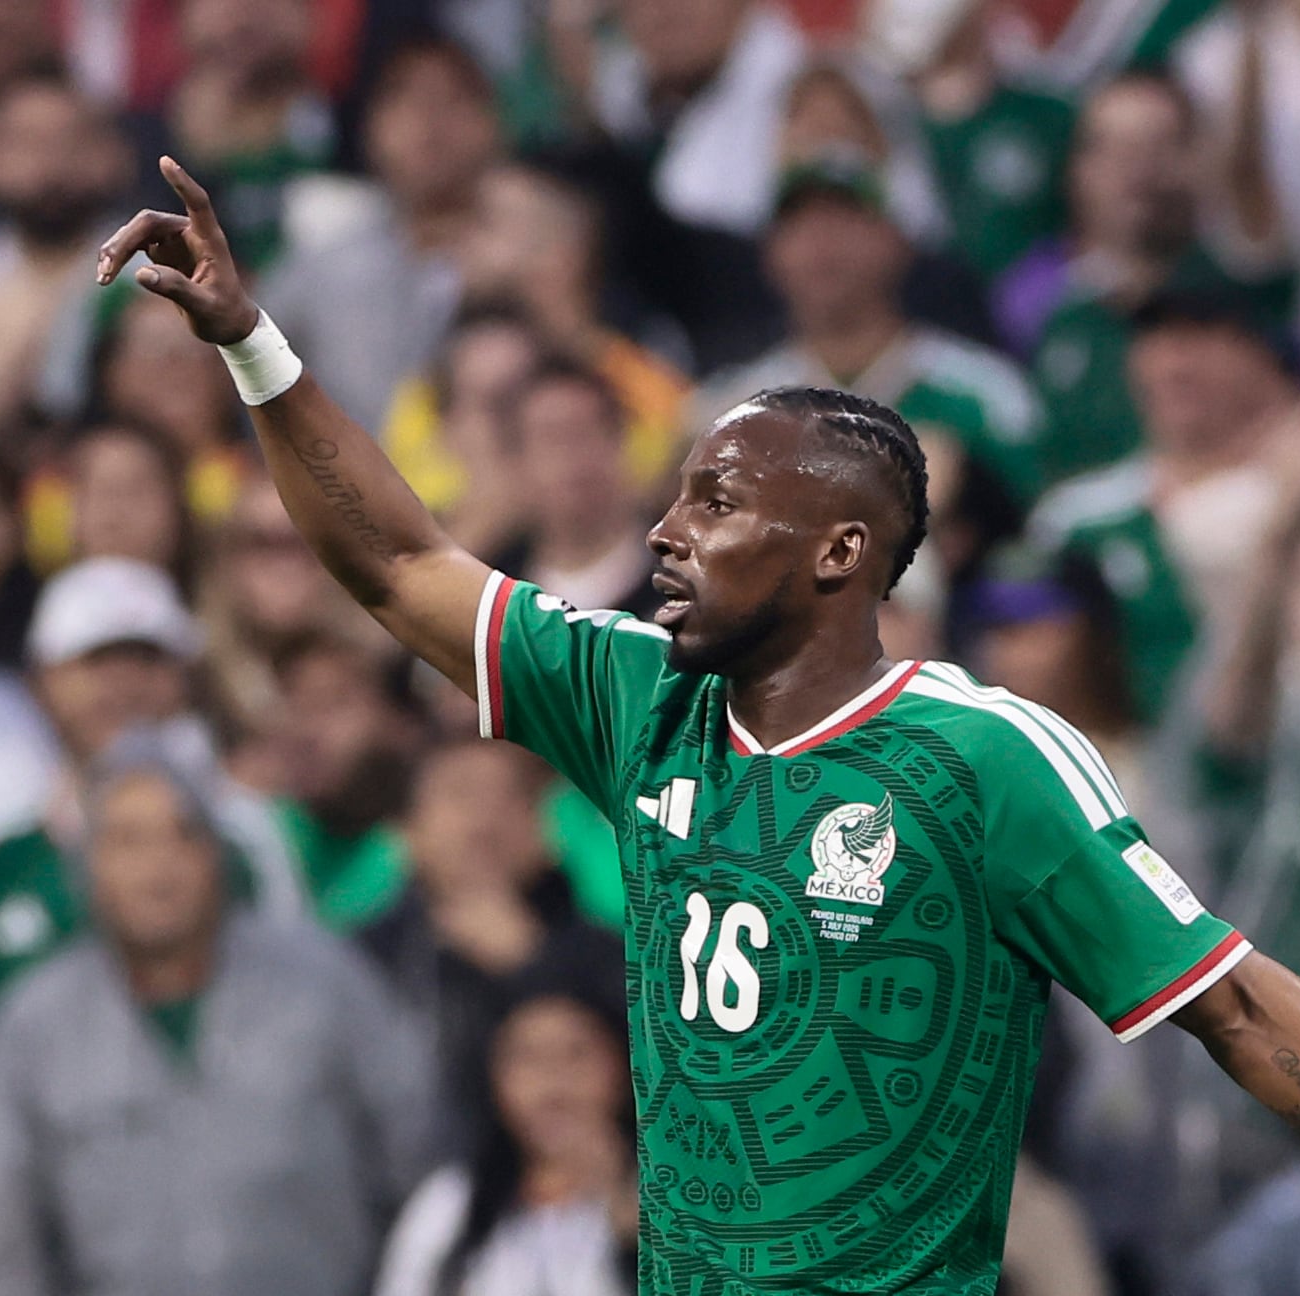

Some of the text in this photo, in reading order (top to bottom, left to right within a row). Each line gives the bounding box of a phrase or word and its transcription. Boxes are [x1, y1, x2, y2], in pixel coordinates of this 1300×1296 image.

[809, 878, 881, 902] MÉXICO
[827, 921, 842, 930] JULY
[845, 913, 874, 926] ENGLAND
[844, 932, 859, 943] CITY
[680, 891, 769, 1033] 16
